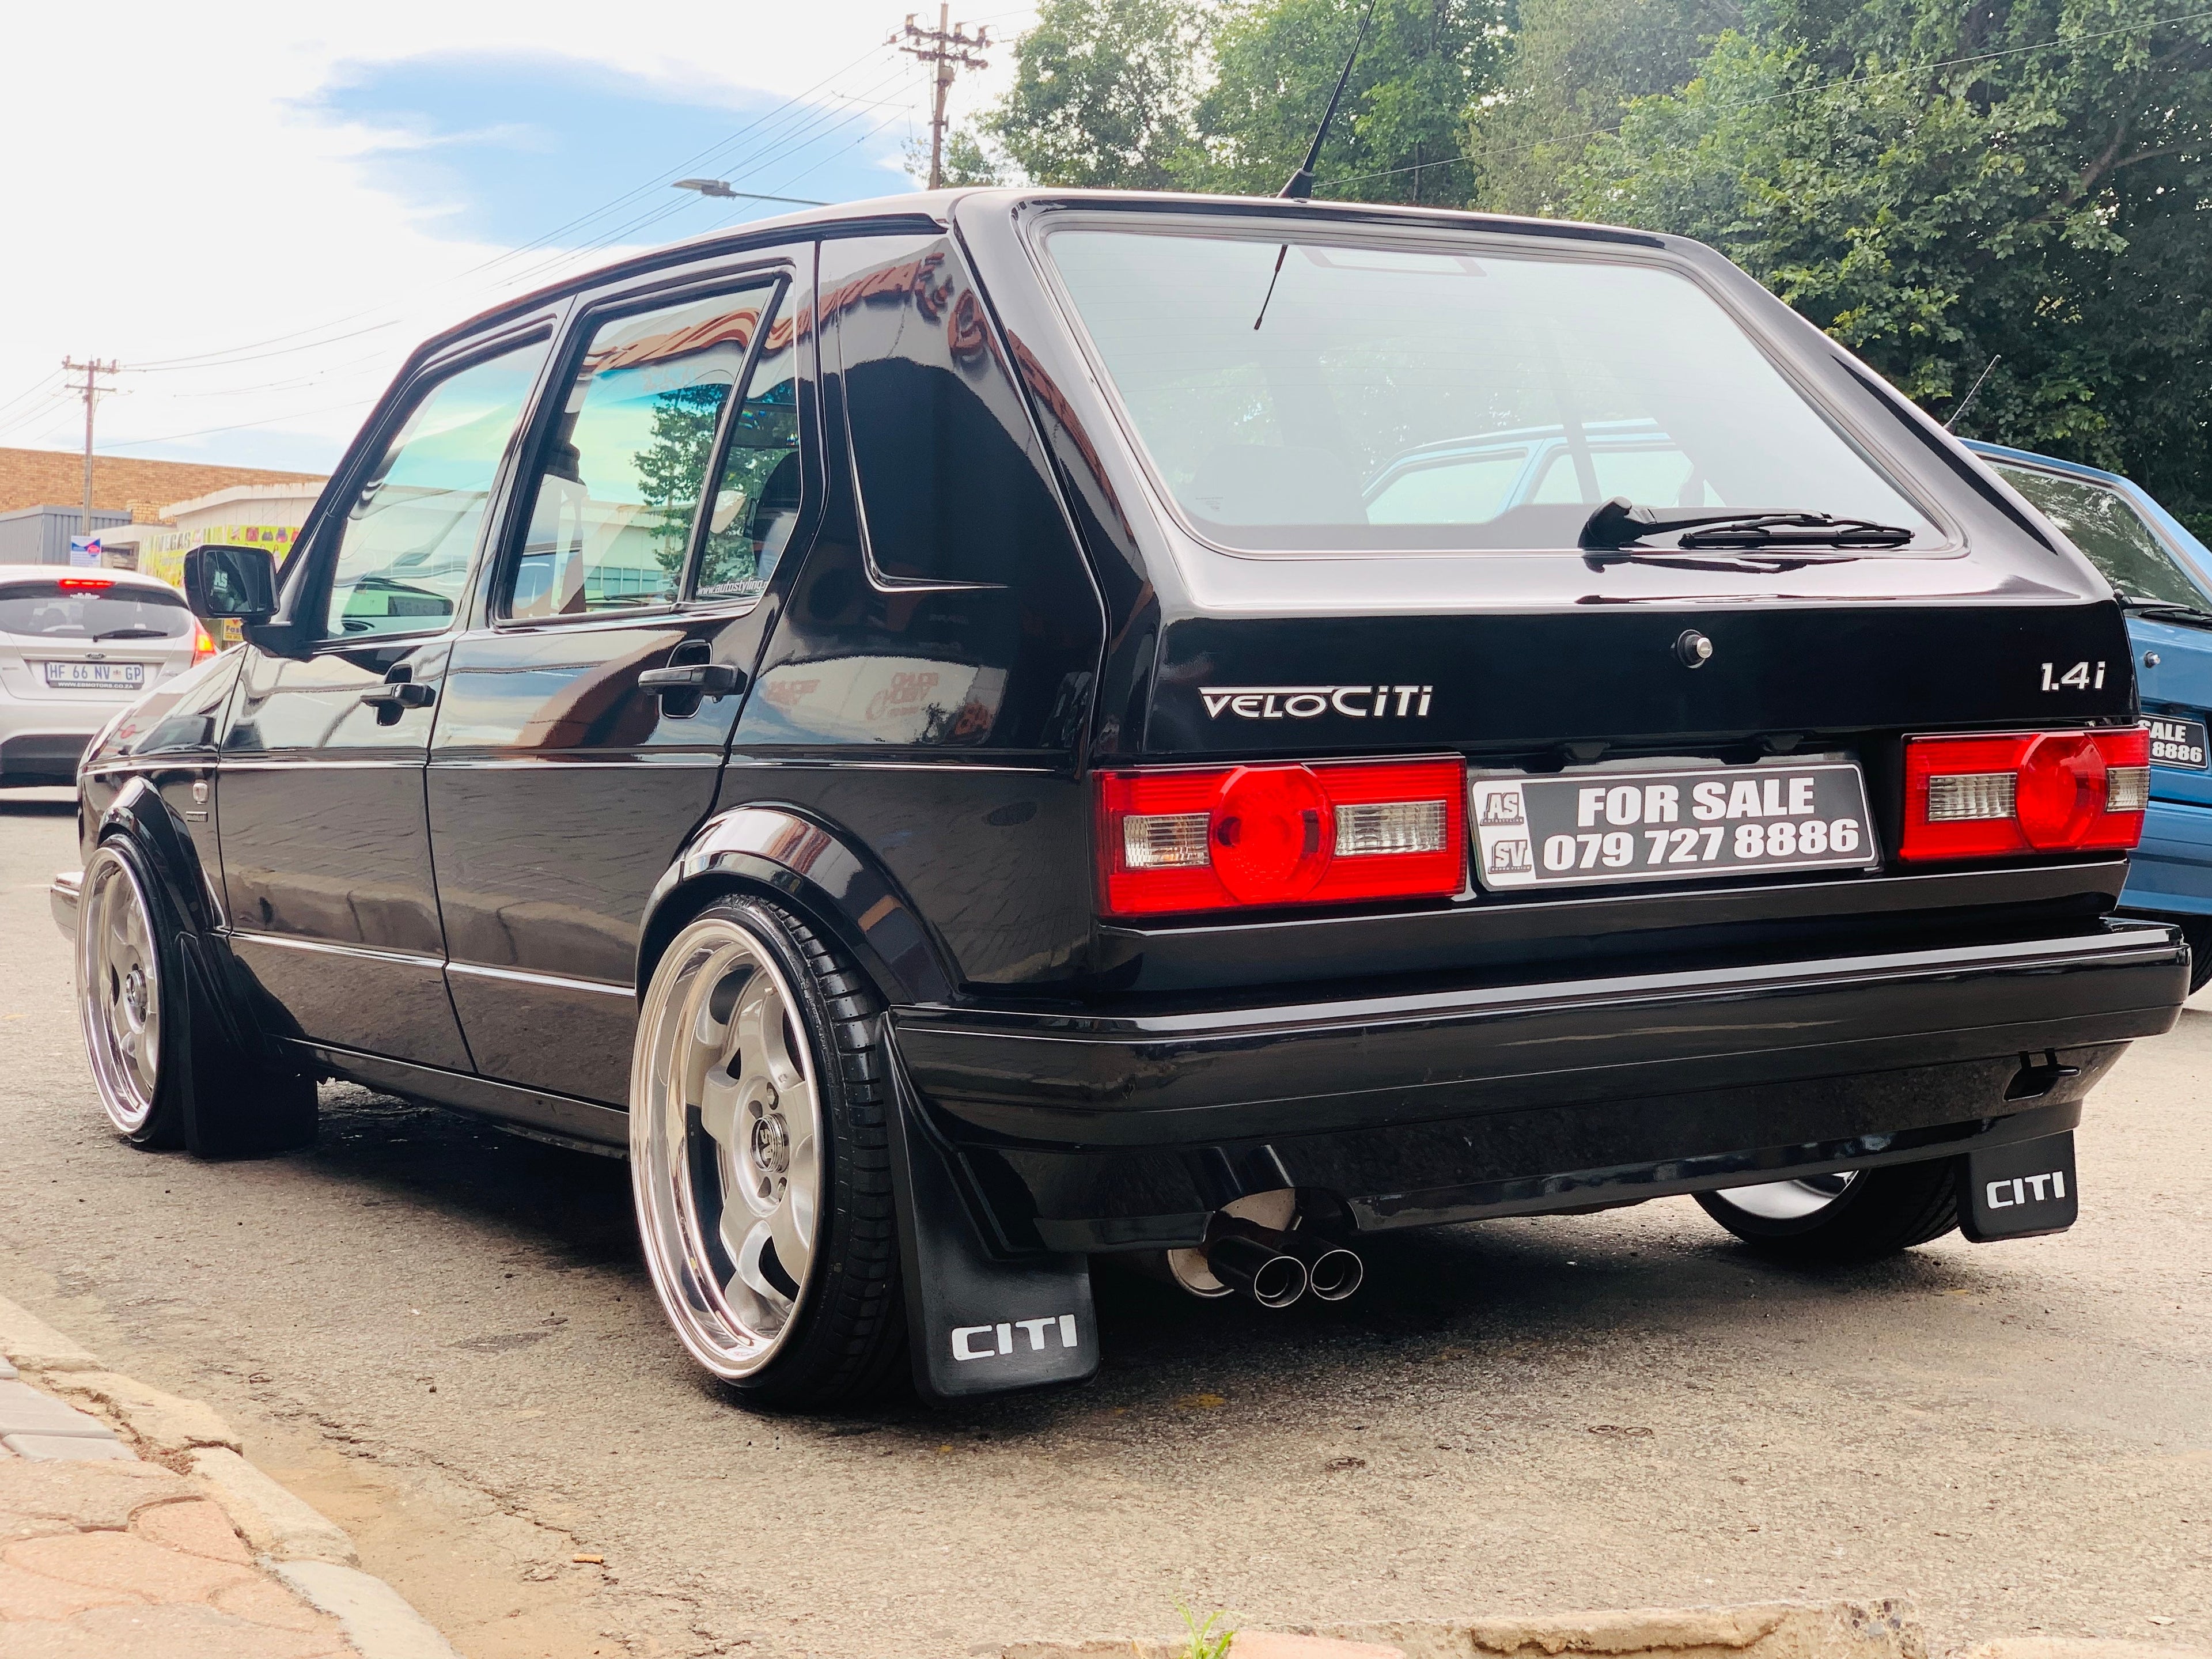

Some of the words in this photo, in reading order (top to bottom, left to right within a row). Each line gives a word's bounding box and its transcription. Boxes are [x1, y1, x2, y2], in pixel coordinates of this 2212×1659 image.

[50, 665, 65, 679] HF
[73, 665, 88, 679] 66
[94, 666, 110, 680] NV
[125, 666, 141, 680] GP
[2041, 661, 2106, 691] 1.4i
[2152, 741, 2203, 763] 8886
[1486, 793, 1518, 820] AS
[1577, 785, 1679, 827] FOR
[1692, 777, 1815, 821] SALE
[1494, 840, 1527, 868] SV
[1543, 831, 1634, 871] 079
[1644, 826, 1725, 865] 727
[1733, 818, 1859, 859] 8886
[1986, 1171, 2066, 1209] CITI
[951, 1313, 1078, 1361] CITI
